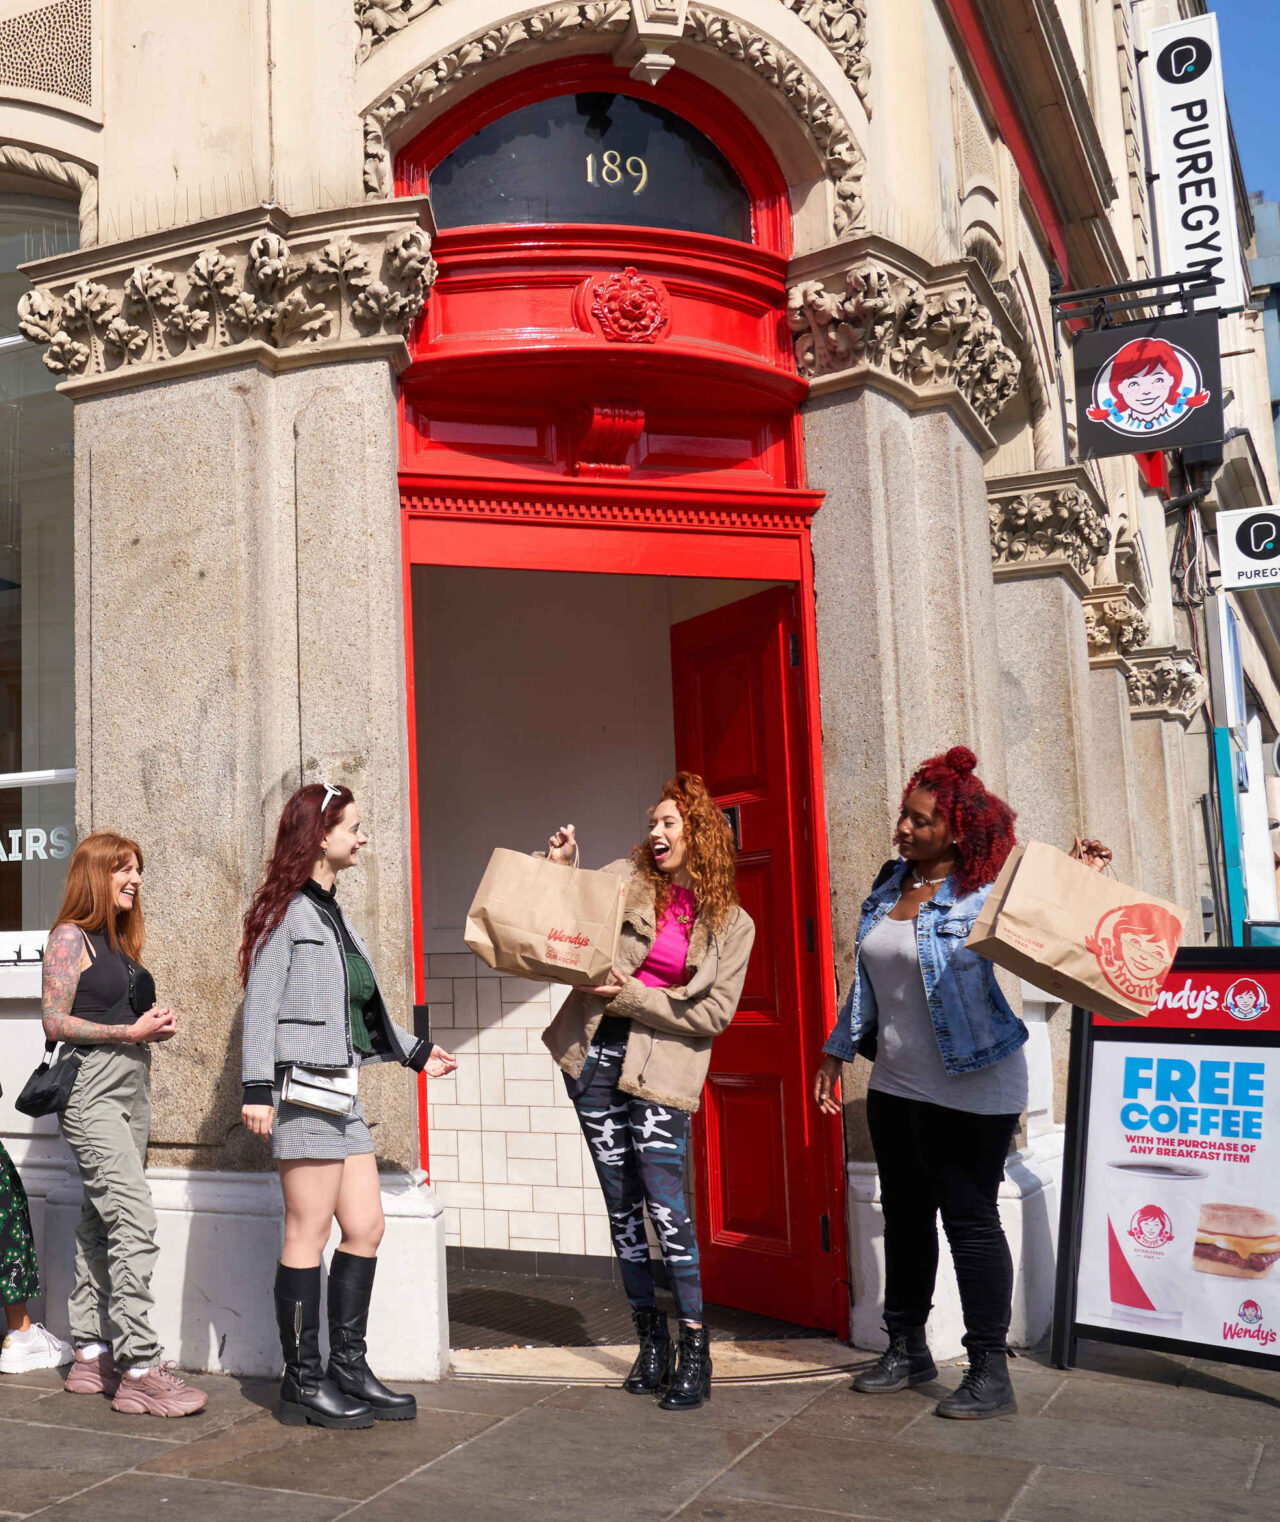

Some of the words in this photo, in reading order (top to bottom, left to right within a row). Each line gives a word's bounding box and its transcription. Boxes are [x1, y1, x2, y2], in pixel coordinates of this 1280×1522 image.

[585, 150, 648, 193] 189
[1170, 98, 1226, 290] PUREGYM
[547, 928, 590, 949] Wendy's
[1123, 1056, 1265, 1108] FREE
[1120, 1102, 1263, 1140] COFFEE
[1125, 1134, 1154, 1145] WITH
[1156, 1137, 1176, 1147] THE
[1177, 1138, 1239, 1153] PURCHASE
[1240, 1144, 1257, 1153] OF
[1130, 1145, 1154, 1155] ANY
[1156, 1147, 1222, 1160] BREAKFAST
[1223, 1153, 1250, 1163] ITEM
[1222, 1321, 1276, 1346] Wendy's
